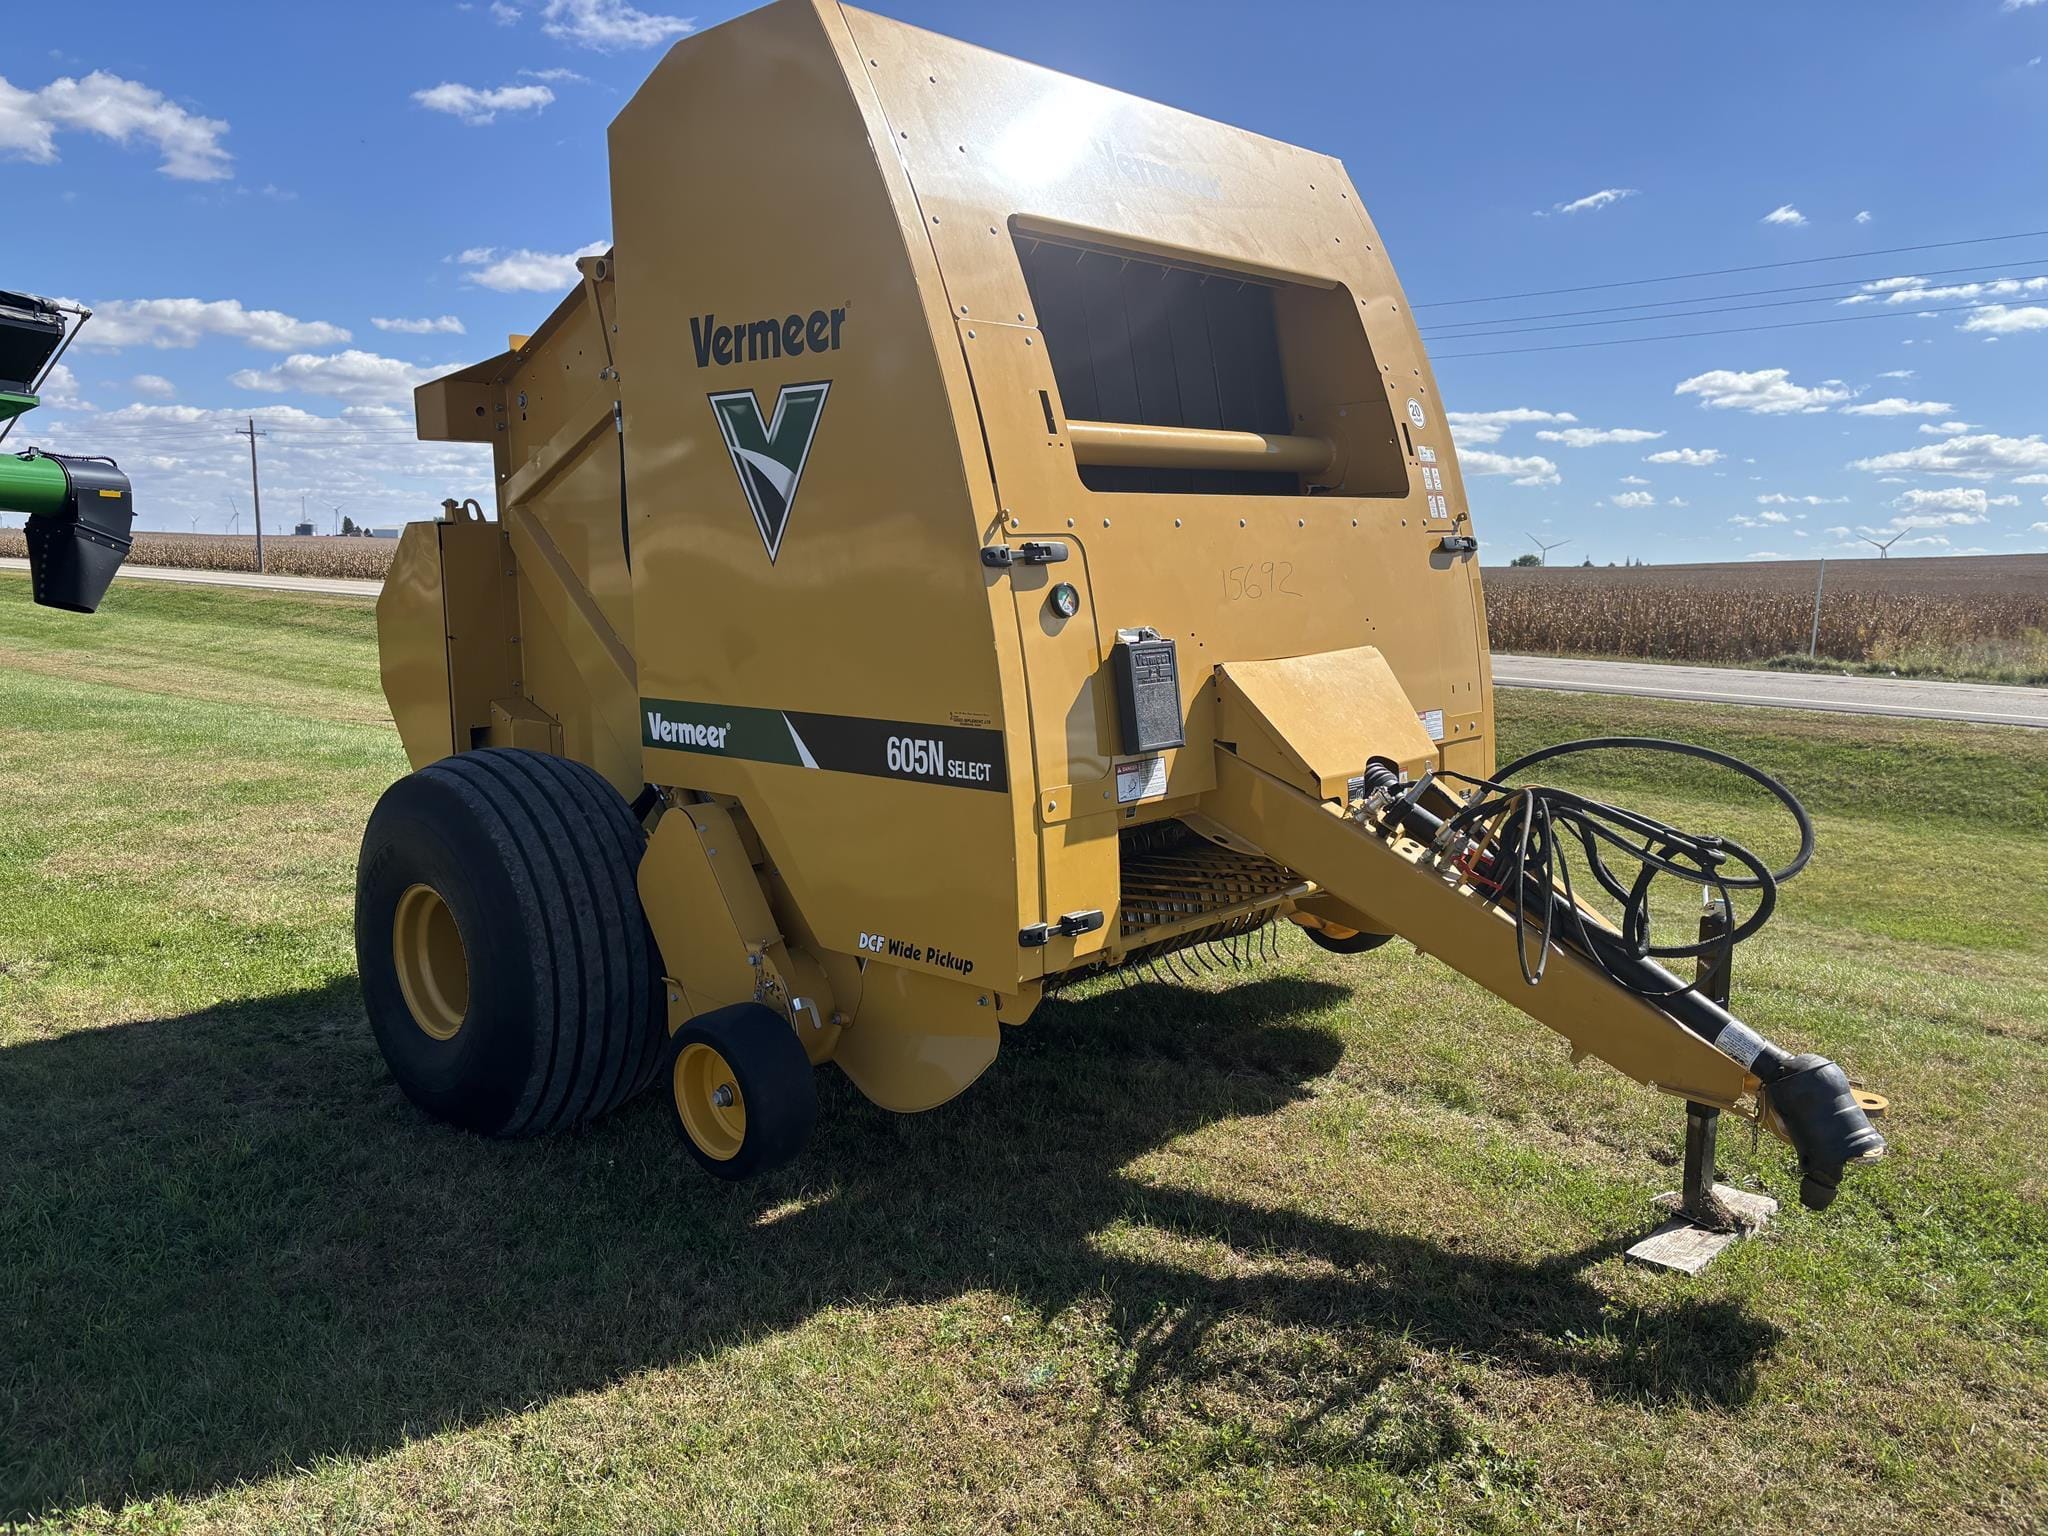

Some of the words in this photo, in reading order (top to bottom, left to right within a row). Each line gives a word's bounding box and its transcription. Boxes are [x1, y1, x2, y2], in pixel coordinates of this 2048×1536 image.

[689, 307, 846, 368] Vermeer
[1409, 404, 1421, 417] 20
[1222, 561, 1303, 600] 15692
[647, 711, 727, 749] Vermeer
[887, 736, 944, 777] 605N
[947, 759, 992, 782] SELECT
[858, 931, 885, 954] DCF
[888, 939, 922, 961] Wide
[925, 947, 974, 975] Pickup
